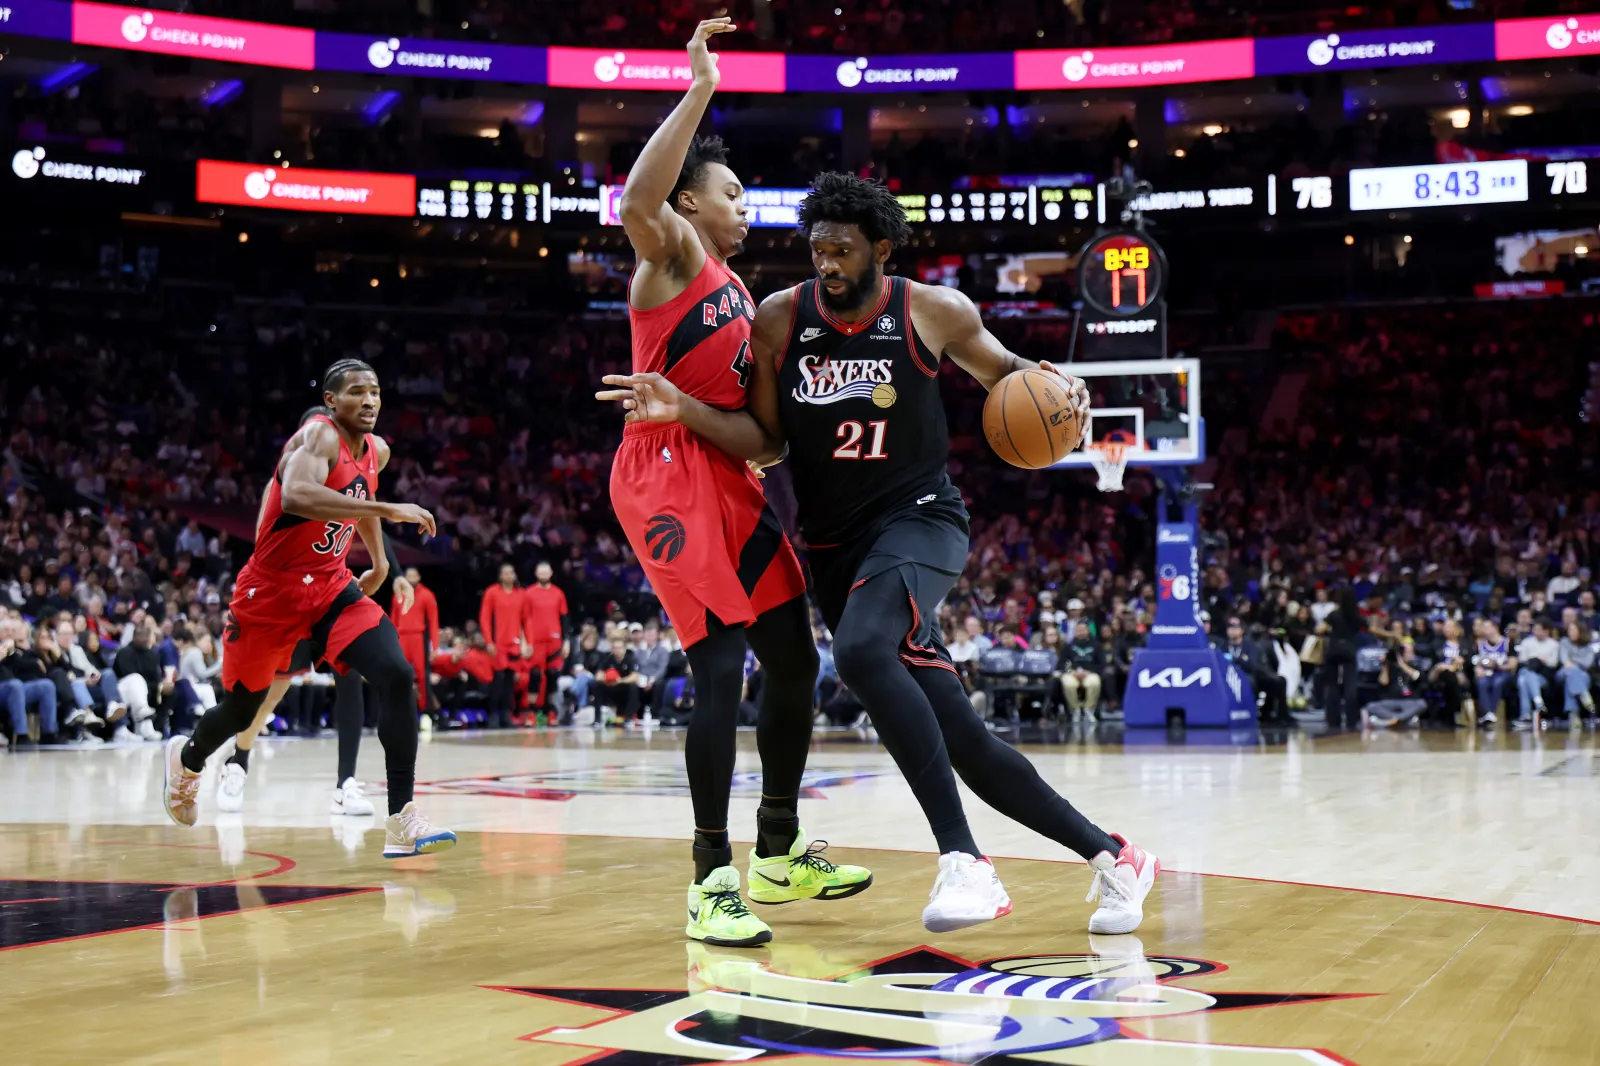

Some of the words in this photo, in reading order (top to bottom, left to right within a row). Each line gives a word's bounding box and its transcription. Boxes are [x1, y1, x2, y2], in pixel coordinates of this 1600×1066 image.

[150, 27, 199, 46] CHECK
[201, 32, 246, 50] POINT
[1336, 44, 1387, 60] CHECK
[1388, 40, 1435, 57] POINT
[396, 51, 446, 69] CHECK
[447, 54, 492, 72] POINT
[1090, 61, 1139, 78] CHECK
[1141, 58, 1185, 75] POINT
[864, 68, 913, 84] CHECK
[914, 67, 959, 82] POINT
[41, 161, 94, 180] CHECK
[95, 166, 146, 185] POINT
[1414, 170, 1481, 200] 8:43
[1545, 161, 1588, 195] 70
[271, 182, 322, 200] CHECK
[322, 186, 373, 203] POINT
[1292, 176, 1333, 210] 76
[1104, 246, 1150, 271] 8:43
[1111, 268, 1147, 308] 17
[803, 327, 822, 336] NIKE
[730, 338, 751, 388] 4
[832, 419, 889, 460] 21
[312, 520, 355, 557] 30
[1138, 667, 1212, 688] KIA
